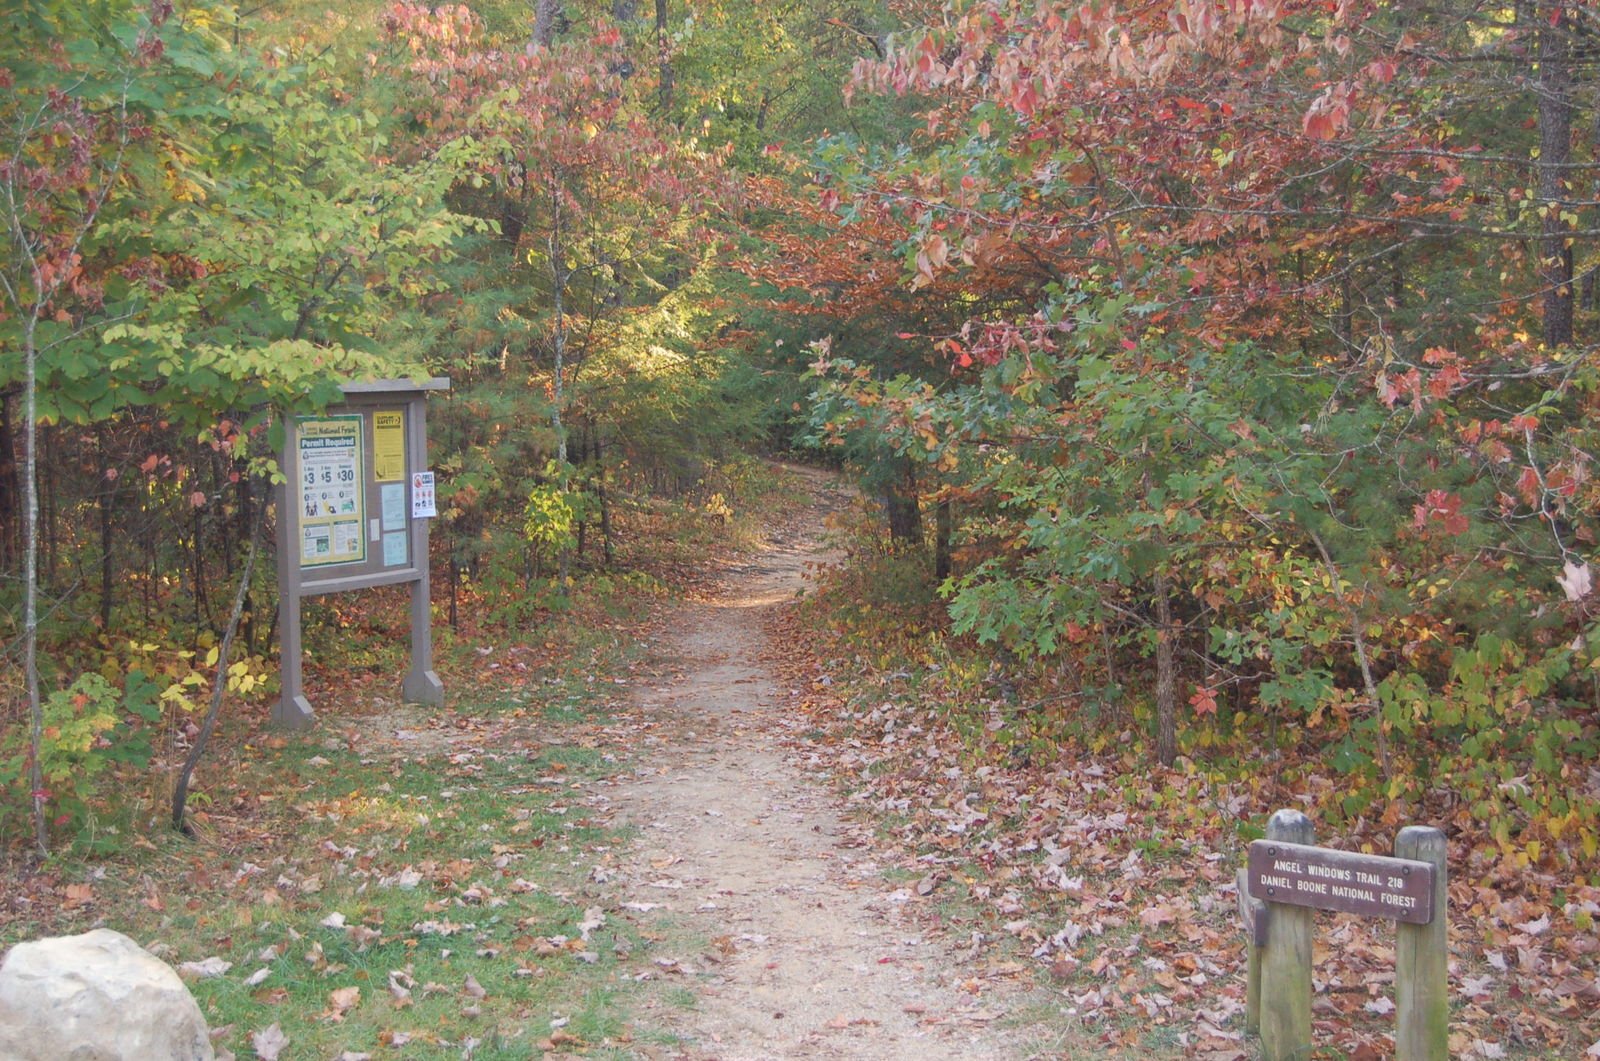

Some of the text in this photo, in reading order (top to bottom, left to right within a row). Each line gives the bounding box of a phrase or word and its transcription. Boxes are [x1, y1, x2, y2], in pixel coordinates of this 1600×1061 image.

[301, 437, 354, 448] Permit Required
[304, 472, 315, 484] $3
[321, 471, 332, 483] $5
[337, 469, 354, 482] $30
[1273, 860, 1404, 889] ANGEL WINDOWS TRAIL 218
[1260, 874, 1417, 908] DANIEL BOONE NATIONAL FOREST
